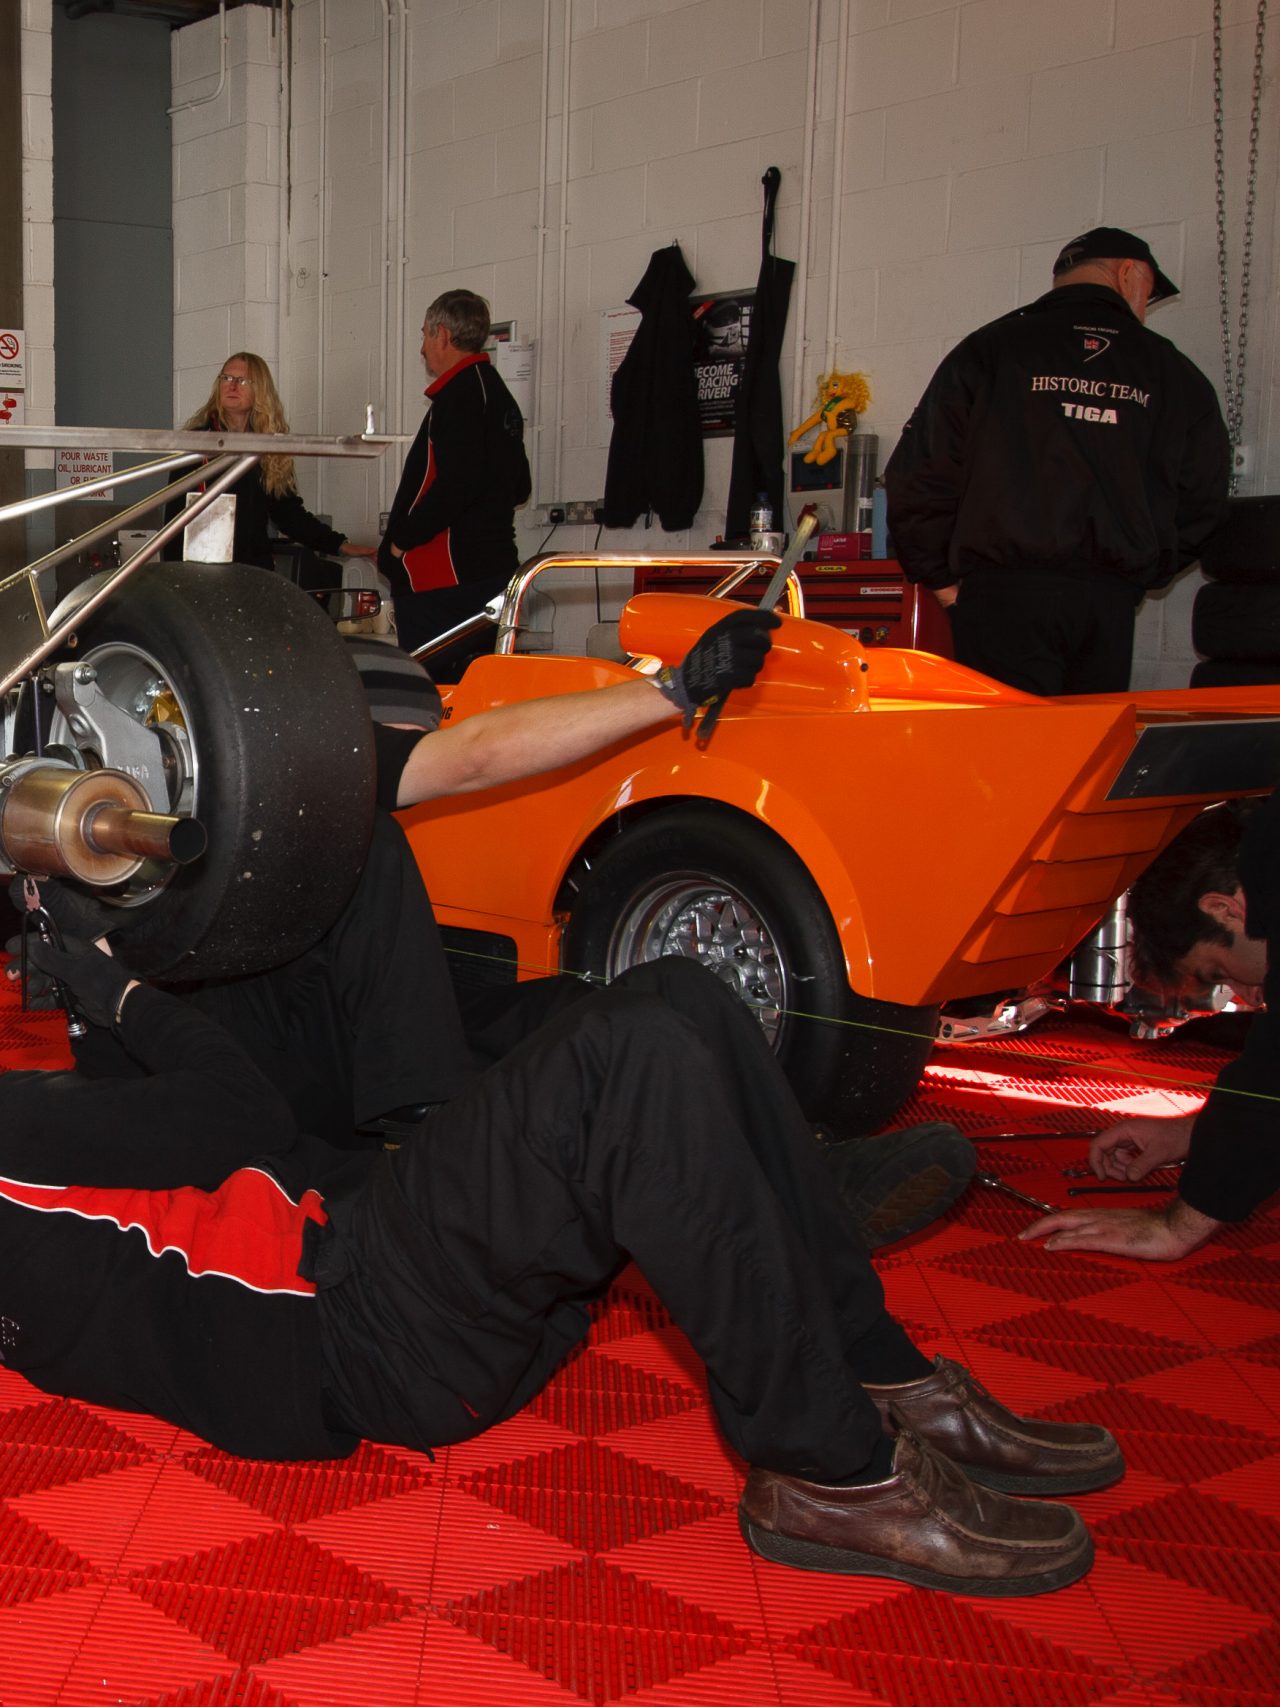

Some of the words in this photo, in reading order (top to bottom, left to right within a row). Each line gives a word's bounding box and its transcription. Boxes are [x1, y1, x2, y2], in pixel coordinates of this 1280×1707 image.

[695, 363, 734, 378] ECOME
[698, 374, 739, 389] RACING
[1031, 376, 1107, 396] HISTORIC
[1110, 383, 1150, 408] TEAM
[1061, 402, 1118, 424] TIGA
[61, 451, 81, 461] POUR
[83, 452, 108, 462] WASTE
[57, 463, 71, 473] OIL,
[73, 464, 112, 473] LUBRICANT
[70, 476, 81, 485] OR
